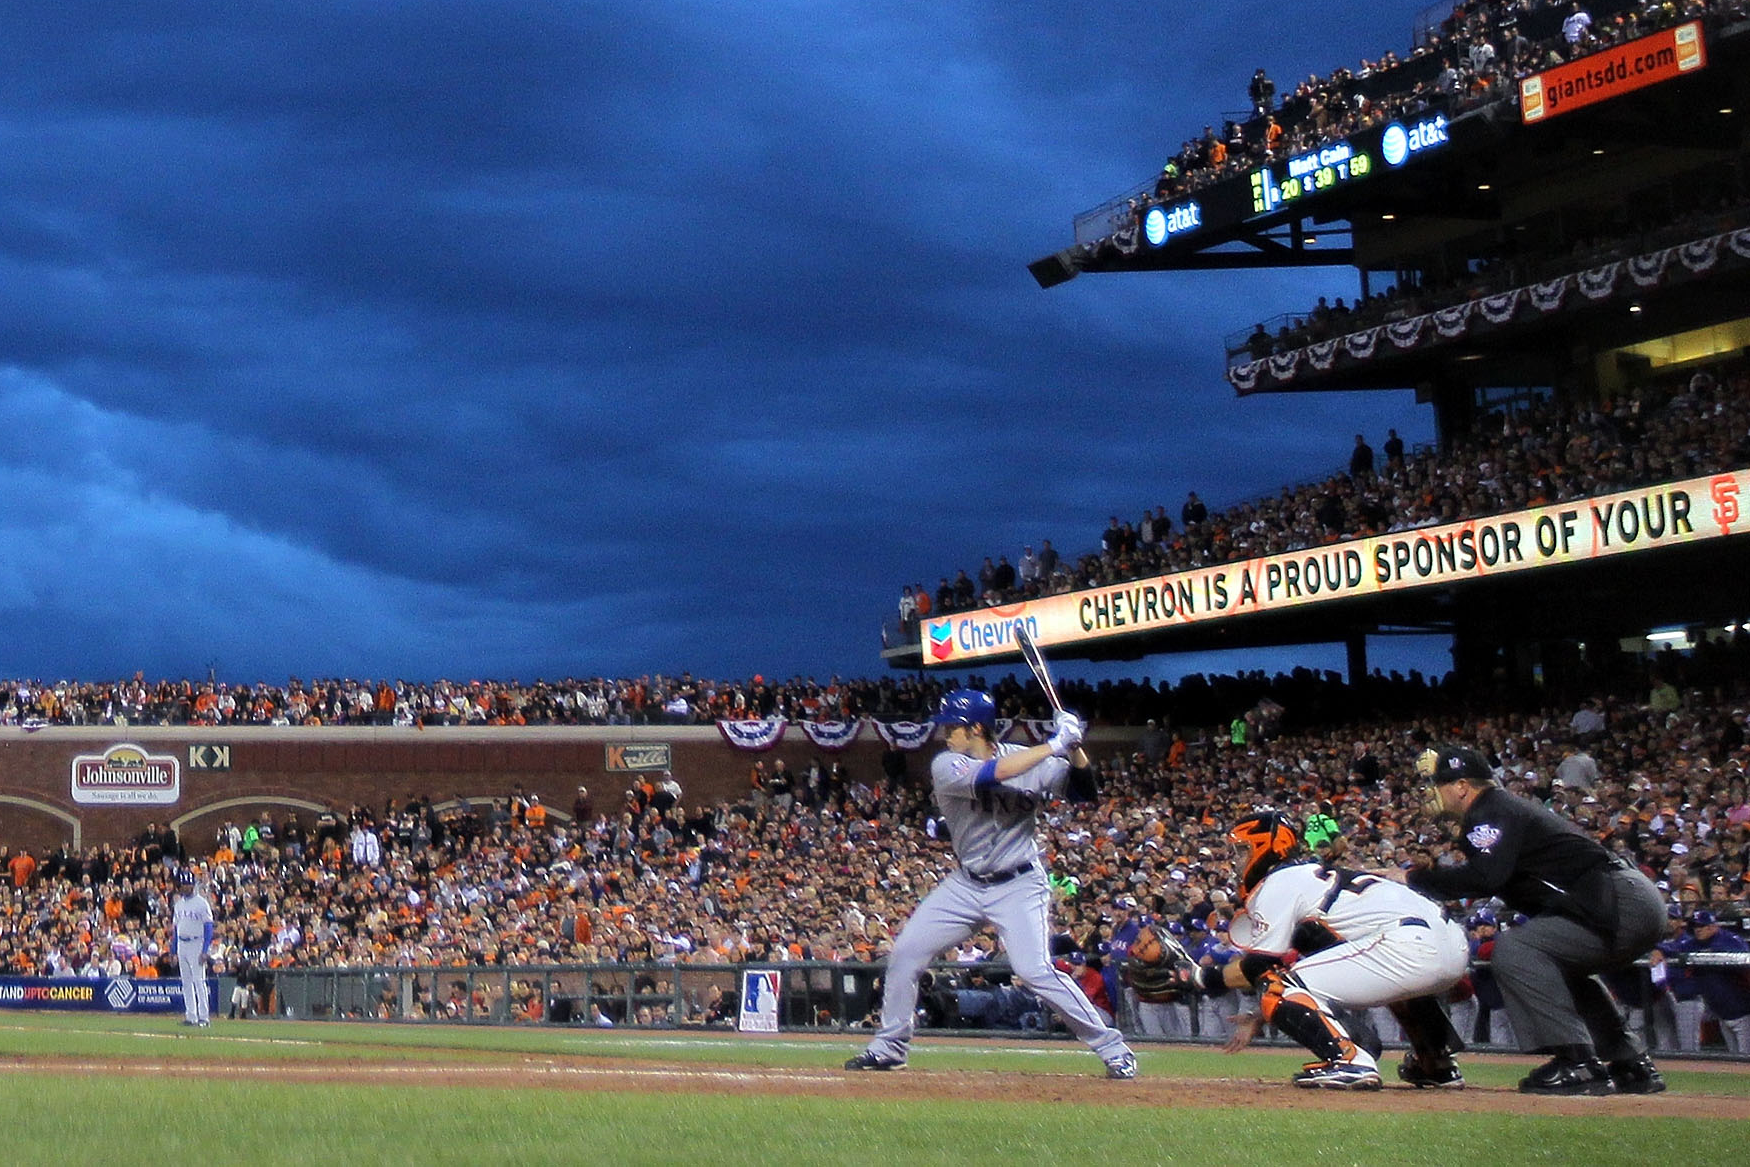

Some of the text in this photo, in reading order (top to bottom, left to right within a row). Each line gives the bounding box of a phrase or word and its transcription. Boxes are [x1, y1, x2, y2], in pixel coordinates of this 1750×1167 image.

[1548, 46, 1675, 108] giantsdd.com
[1409, 115, 1447, 151] at&t
[1281, 178, 1300, 201] 20
[1303, 175, 1313, 192] S
[1315, 167, 1334, 189] 39
[1337, 163, 1347, 180] T
[1350, 154, 1369, 176] 59
[1167, 202, 1199, 233] at&t
[1079, 578, 1195, 632] CHEVRON
[1205, 569, 1229, 611] IS
[1240, 568, 1257, 605] A
[1266, 550, 1362, 601] PROUD
[1375, 521, 1524, 582] SPONSOR
[1536, 510, 1578, 557] OF
[1590, 490, 1694, 547] YOUR
[82, 765, 168, 785] Johnsonville
[189, 745, 207, 769] K
